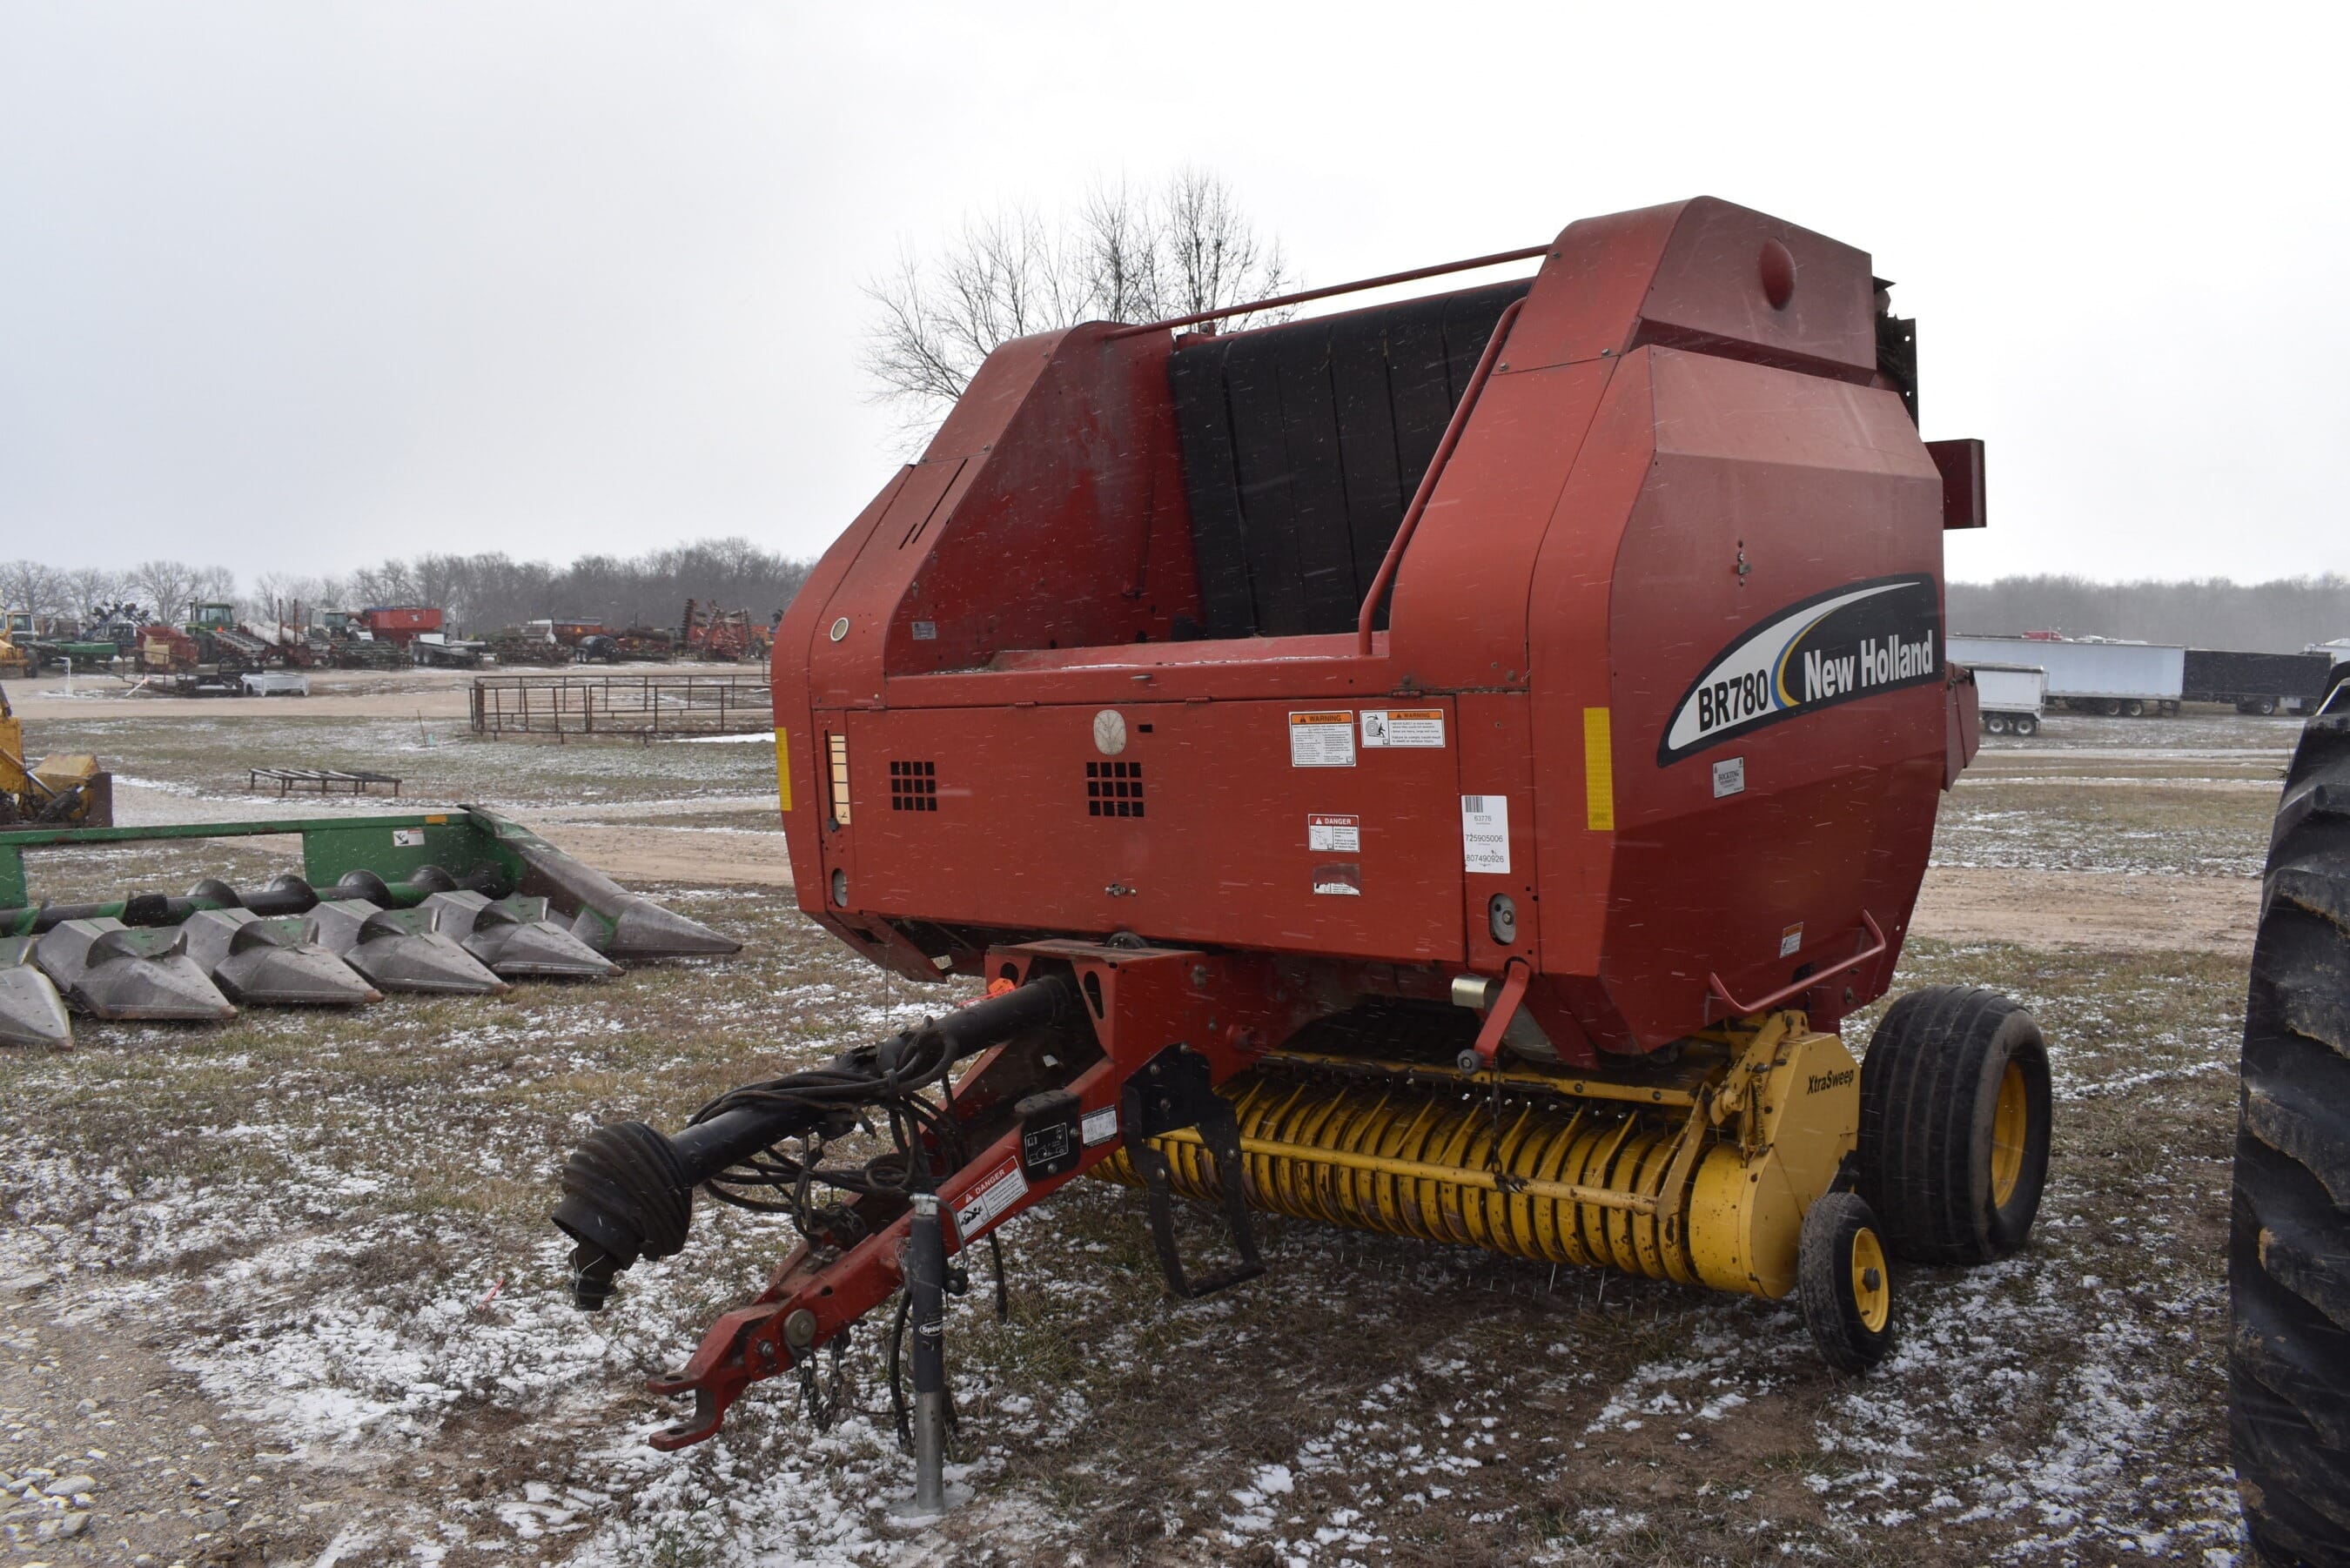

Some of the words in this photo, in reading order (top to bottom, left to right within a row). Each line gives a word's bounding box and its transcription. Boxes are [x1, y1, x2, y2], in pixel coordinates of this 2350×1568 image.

[1804, 649, 1856, 702] New
[1861, 629, 1934, 688] Holland
[1698, 668, 1769, 733] BR780
[1807, 1069, 1854, 1095] XtraSweep
[975, 1169, 1005, 1195] DANGER
